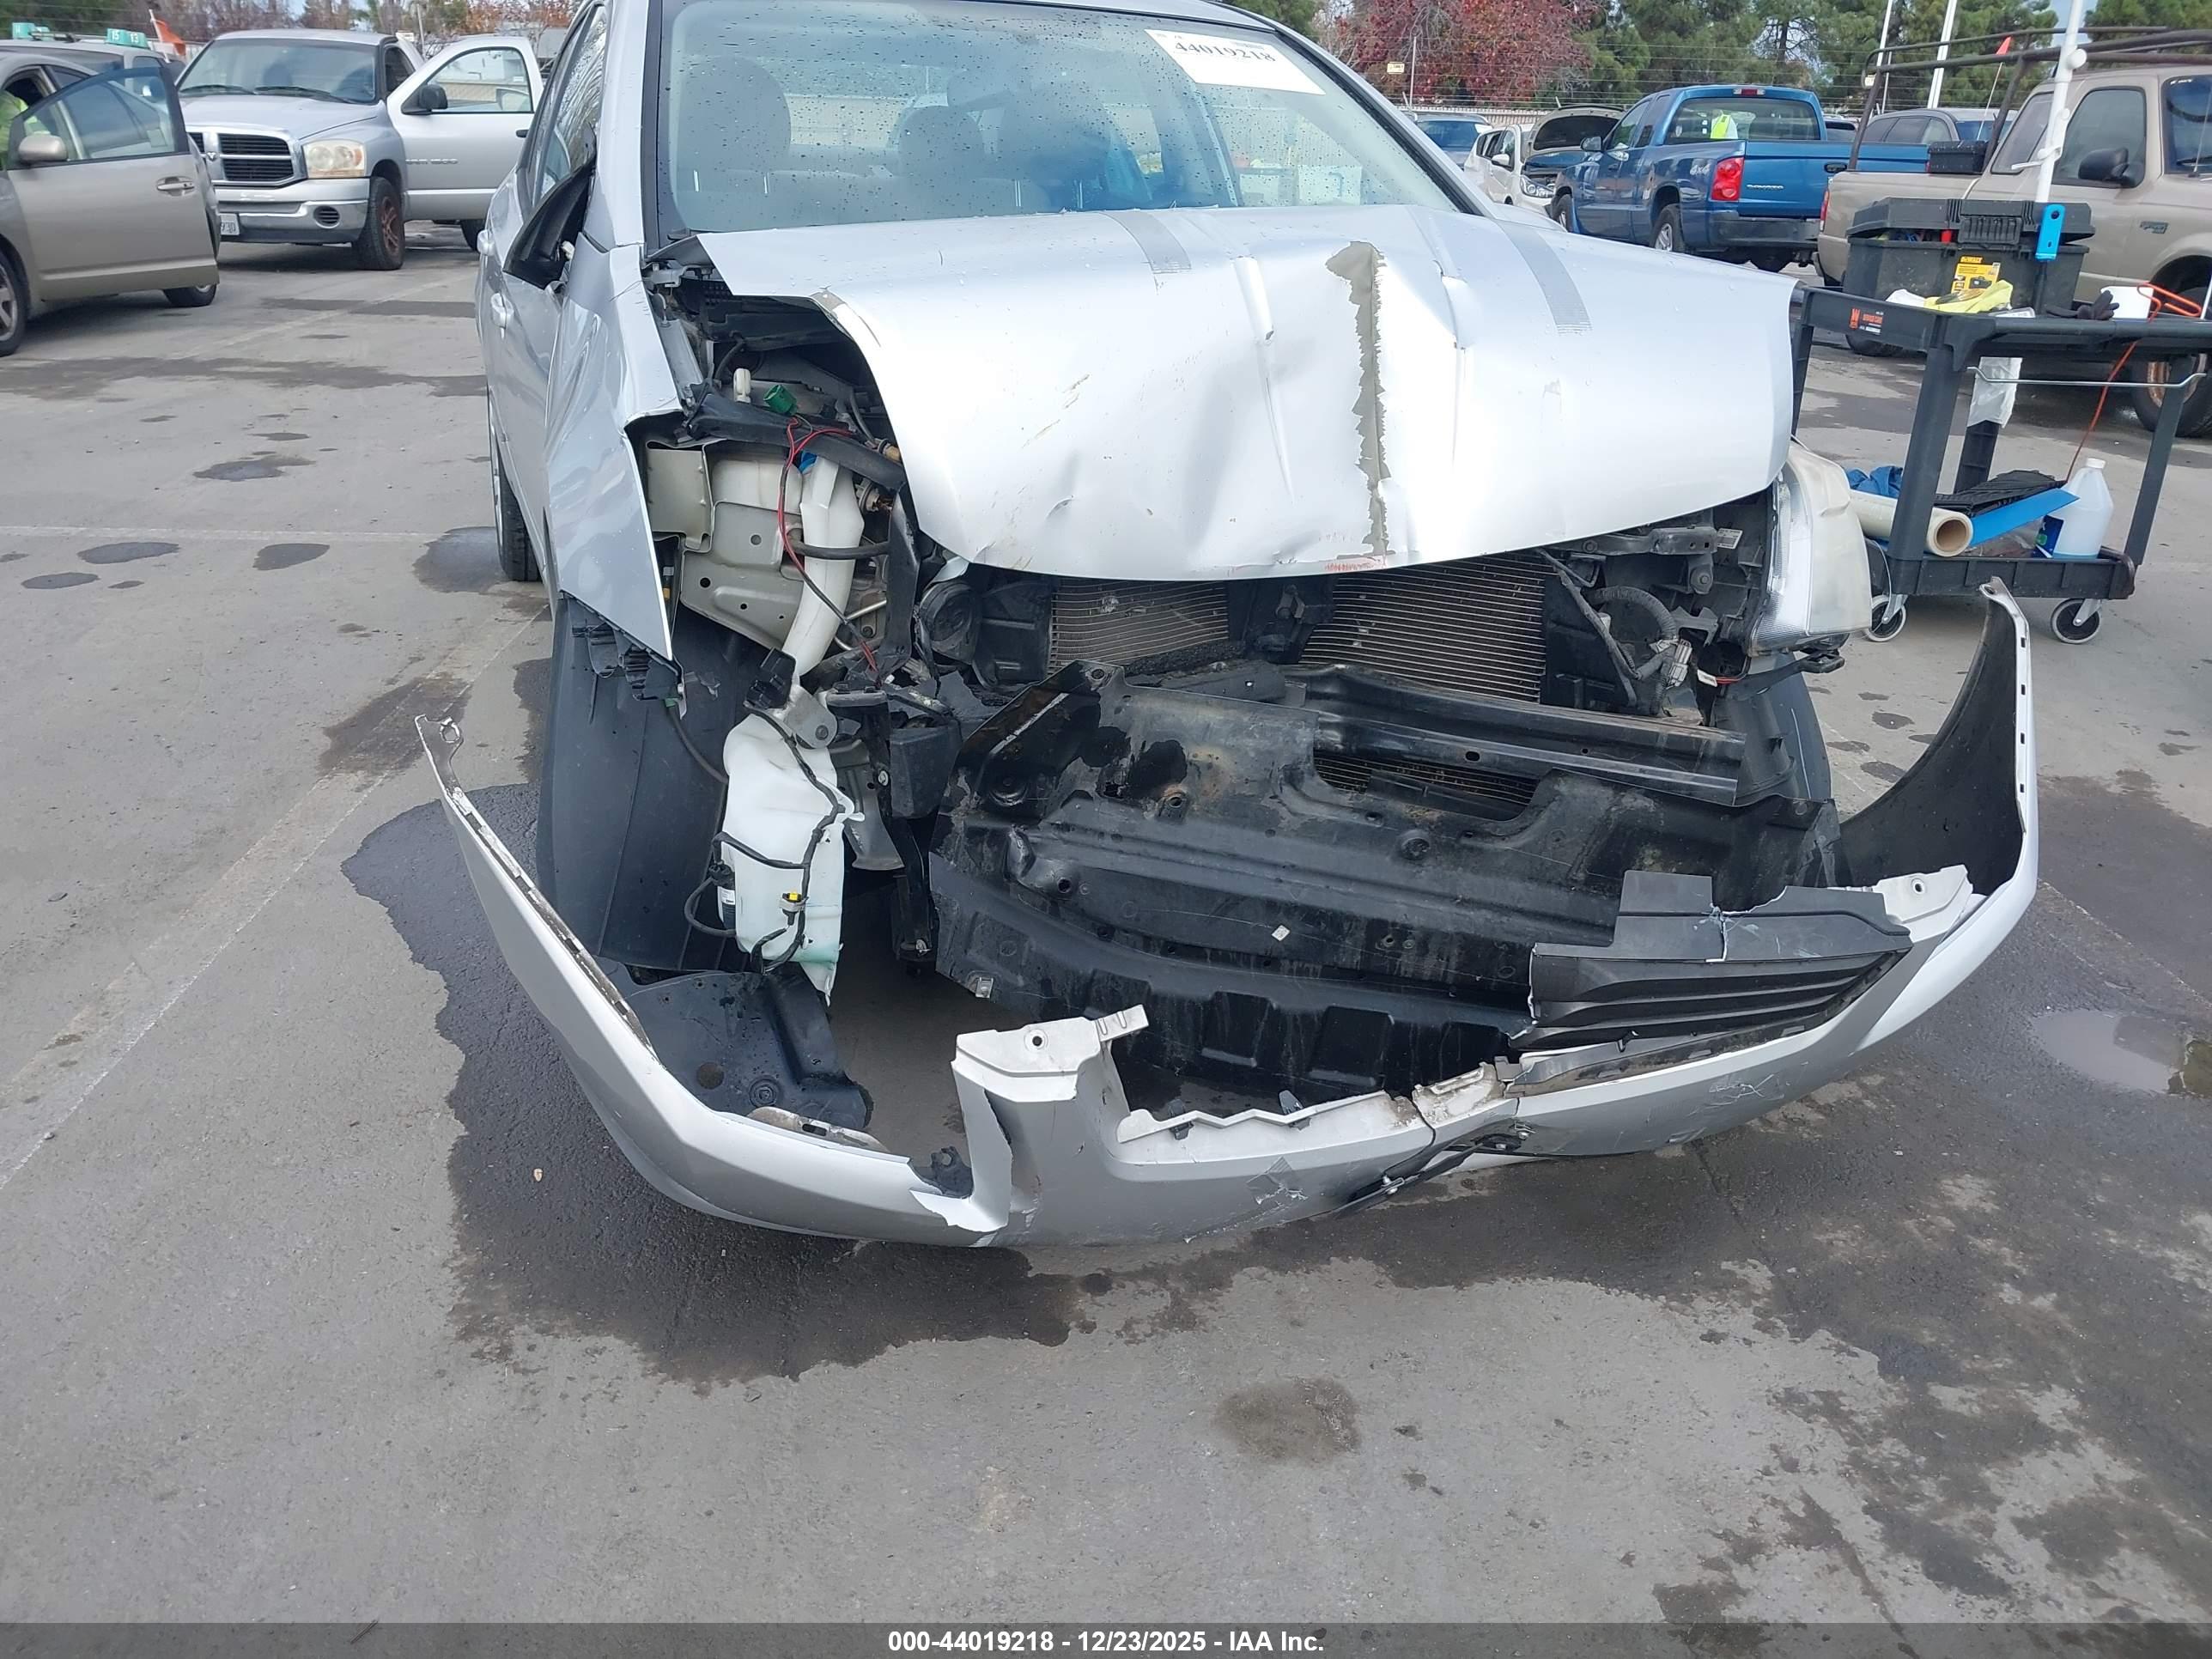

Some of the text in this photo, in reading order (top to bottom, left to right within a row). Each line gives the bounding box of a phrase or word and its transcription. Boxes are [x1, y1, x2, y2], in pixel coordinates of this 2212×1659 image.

[112, 30, 119, 40] 15
[130, 33, 139, 43] 13
[1175, 41, 1277, 63] 44019218
[1690, 163, 1711, 175] 4x4
